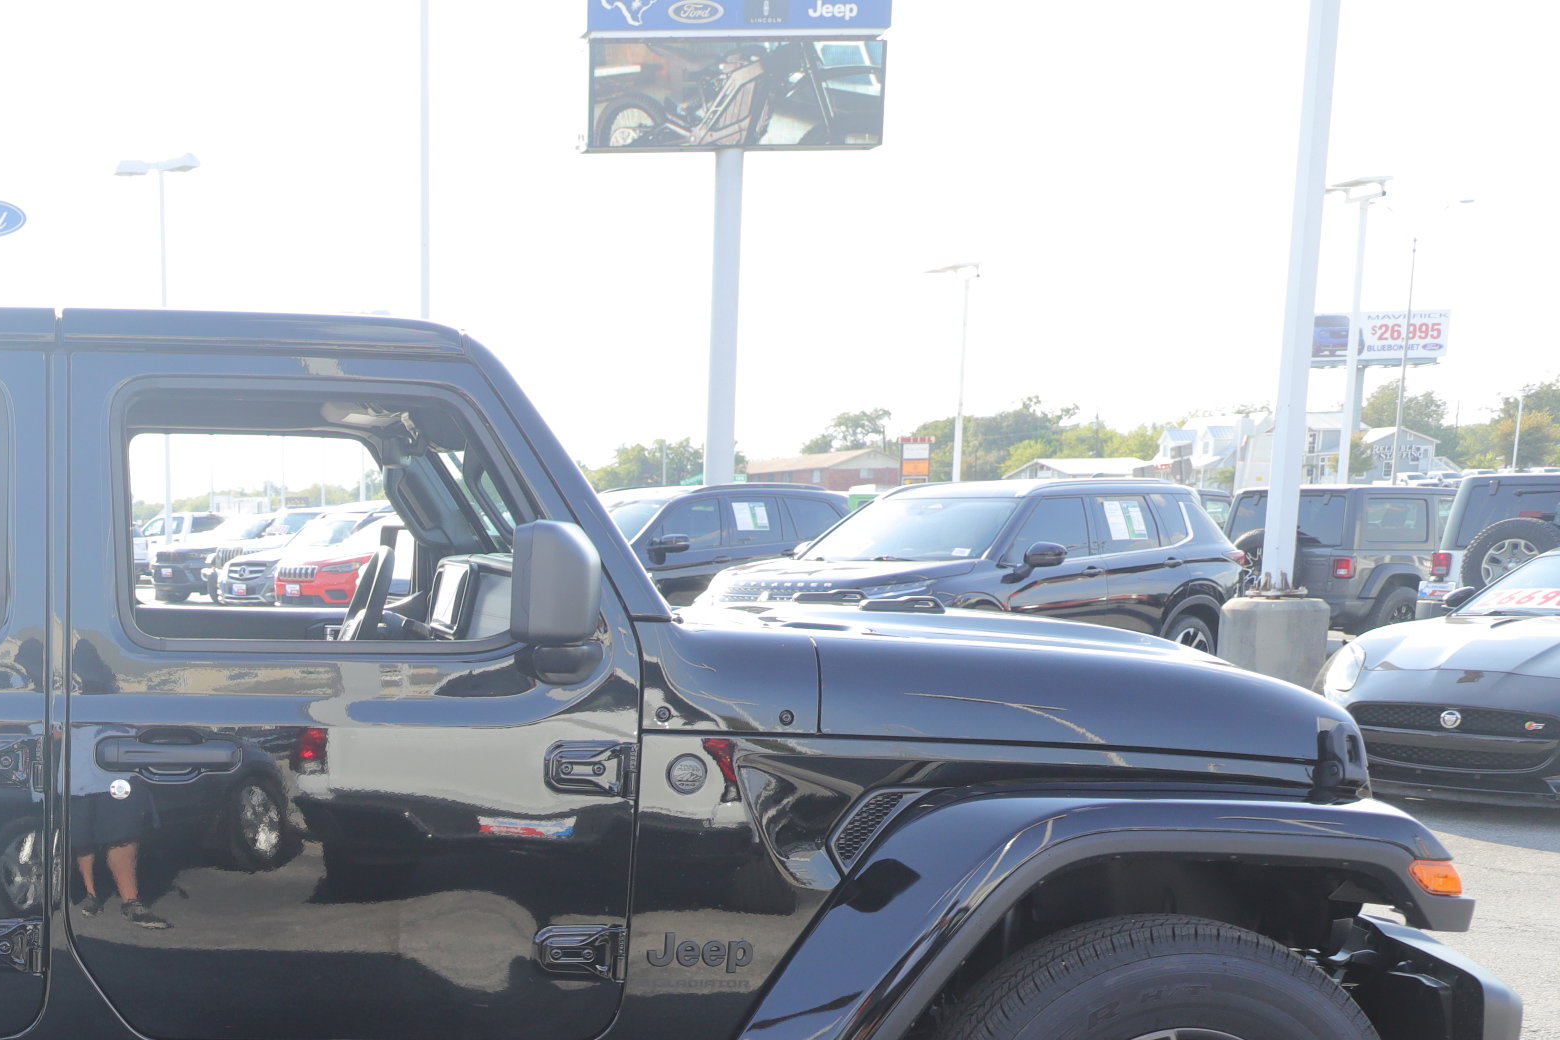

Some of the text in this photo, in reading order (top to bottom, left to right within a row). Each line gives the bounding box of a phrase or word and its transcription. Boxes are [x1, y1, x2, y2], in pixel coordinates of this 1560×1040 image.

[680, 4, 711, 18] Ford
[808, 0, 858, 21] Jeep
[1371, 322, 1442, 342] $26,995
[1372, 444, 1416, 454] RELIBLE
[1478, 589, 1560, 606] 2669
[646, 931, 754, 974] Jeep
[651, 979, 750, 989] GLADIATOR
